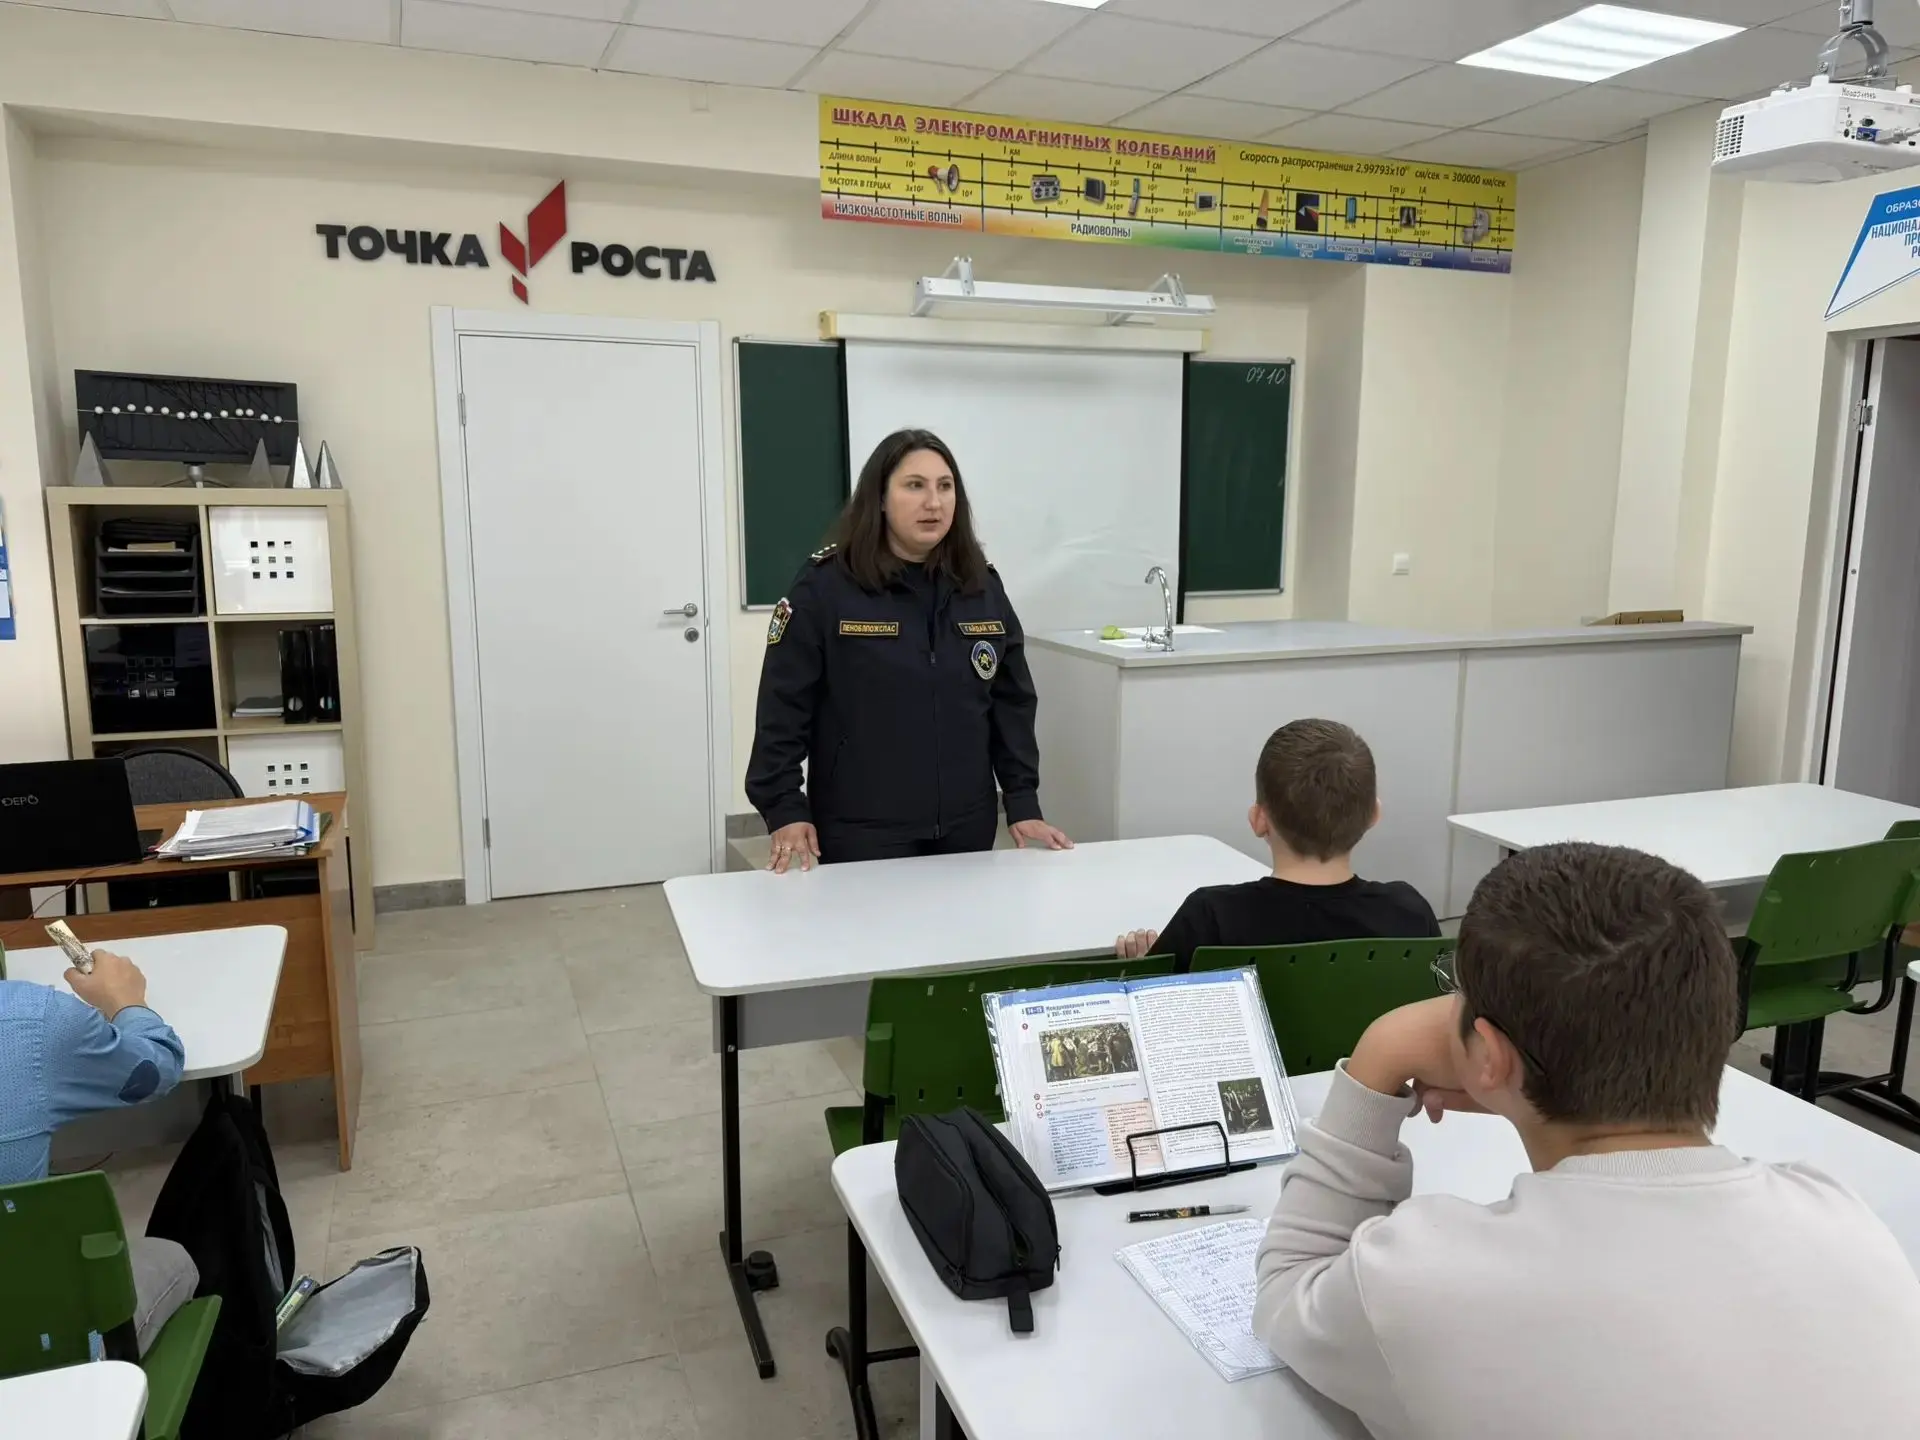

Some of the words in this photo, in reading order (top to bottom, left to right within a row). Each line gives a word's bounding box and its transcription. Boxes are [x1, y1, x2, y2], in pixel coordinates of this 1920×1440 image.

[833, 108, 907, 130] ШКАЛА
[914, 116, 1112, 153] ЭЛЕКТРОМАГНИТНЫХ
[1116, 139, 1217, 163] КОЛЕБАНИЙ
[828, 151, 854, 161] ДЛИНА
[855, 154, 882, 164] ВОЛНЫ
[1240, 150, 1280, 165] Скорость
[1281, 156, 1354, 172] распространения
[1452, 172, 1480, 185] 300000
[828, 176, 858, 188] ЧАСТОТА
[866, 180, 892, 190] ГЕРЦАХ
[834, 203, 925, 221] НИЗКОЧАСТОТНЫЕ
[928, 211, 962, 223] ВОЛНЫ
[1070, 223, 1131, 238] РАДИОВОЛНЫ
[1871, 219, 1920, 239] НАЦИОНА
[316, 223, 490, 268] ТОЧКА
[570, 241, 717, 282] РОСТА
